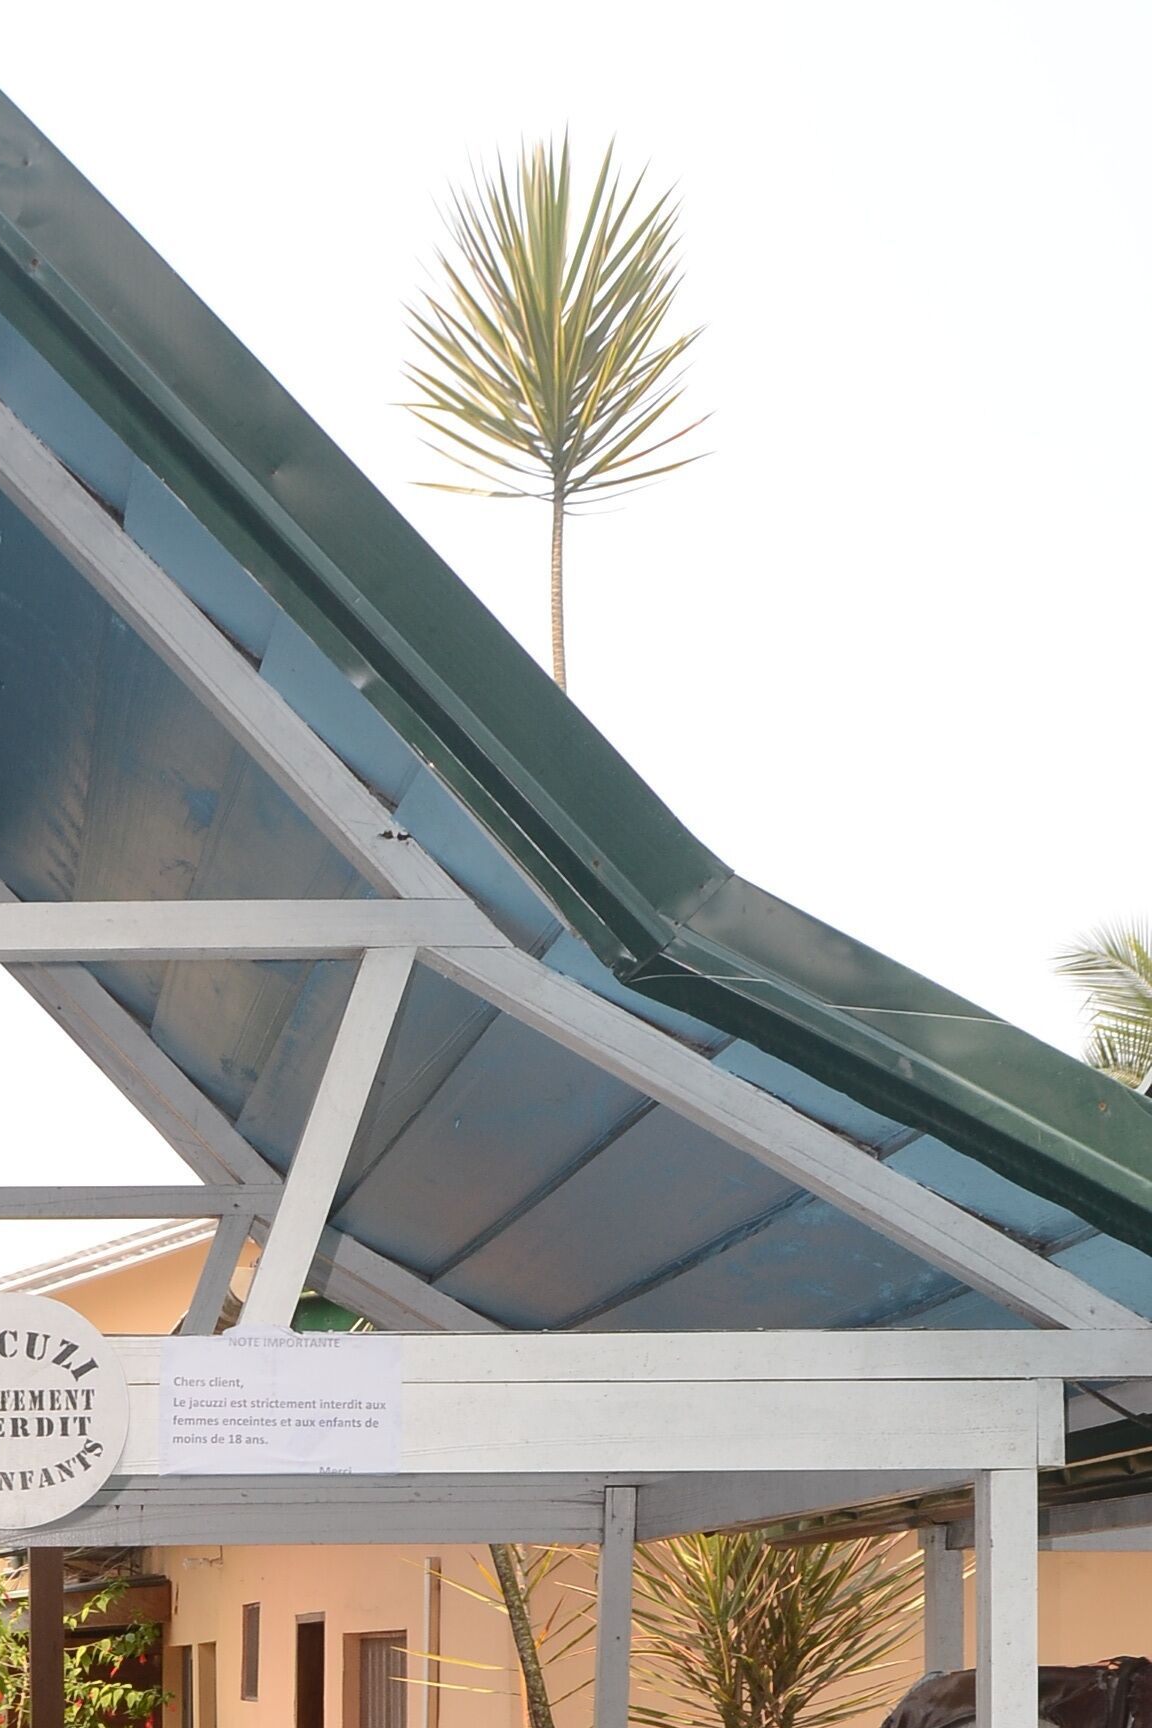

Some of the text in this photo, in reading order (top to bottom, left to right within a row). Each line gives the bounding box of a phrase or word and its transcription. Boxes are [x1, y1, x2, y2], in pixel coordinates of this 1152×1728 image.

[229, 1337, 341, 1349] NOTE IMPORTANTE
[174, 1377, 245, 1390] Chers client,
[173, 1398, 387, 1411] Le jacuzzi est strictement interdit aux
[173, 1416, 380, 1429] femmes enceintes et aux enfants de
[173, 1435, 269, 1446] moins de 18 ans.
